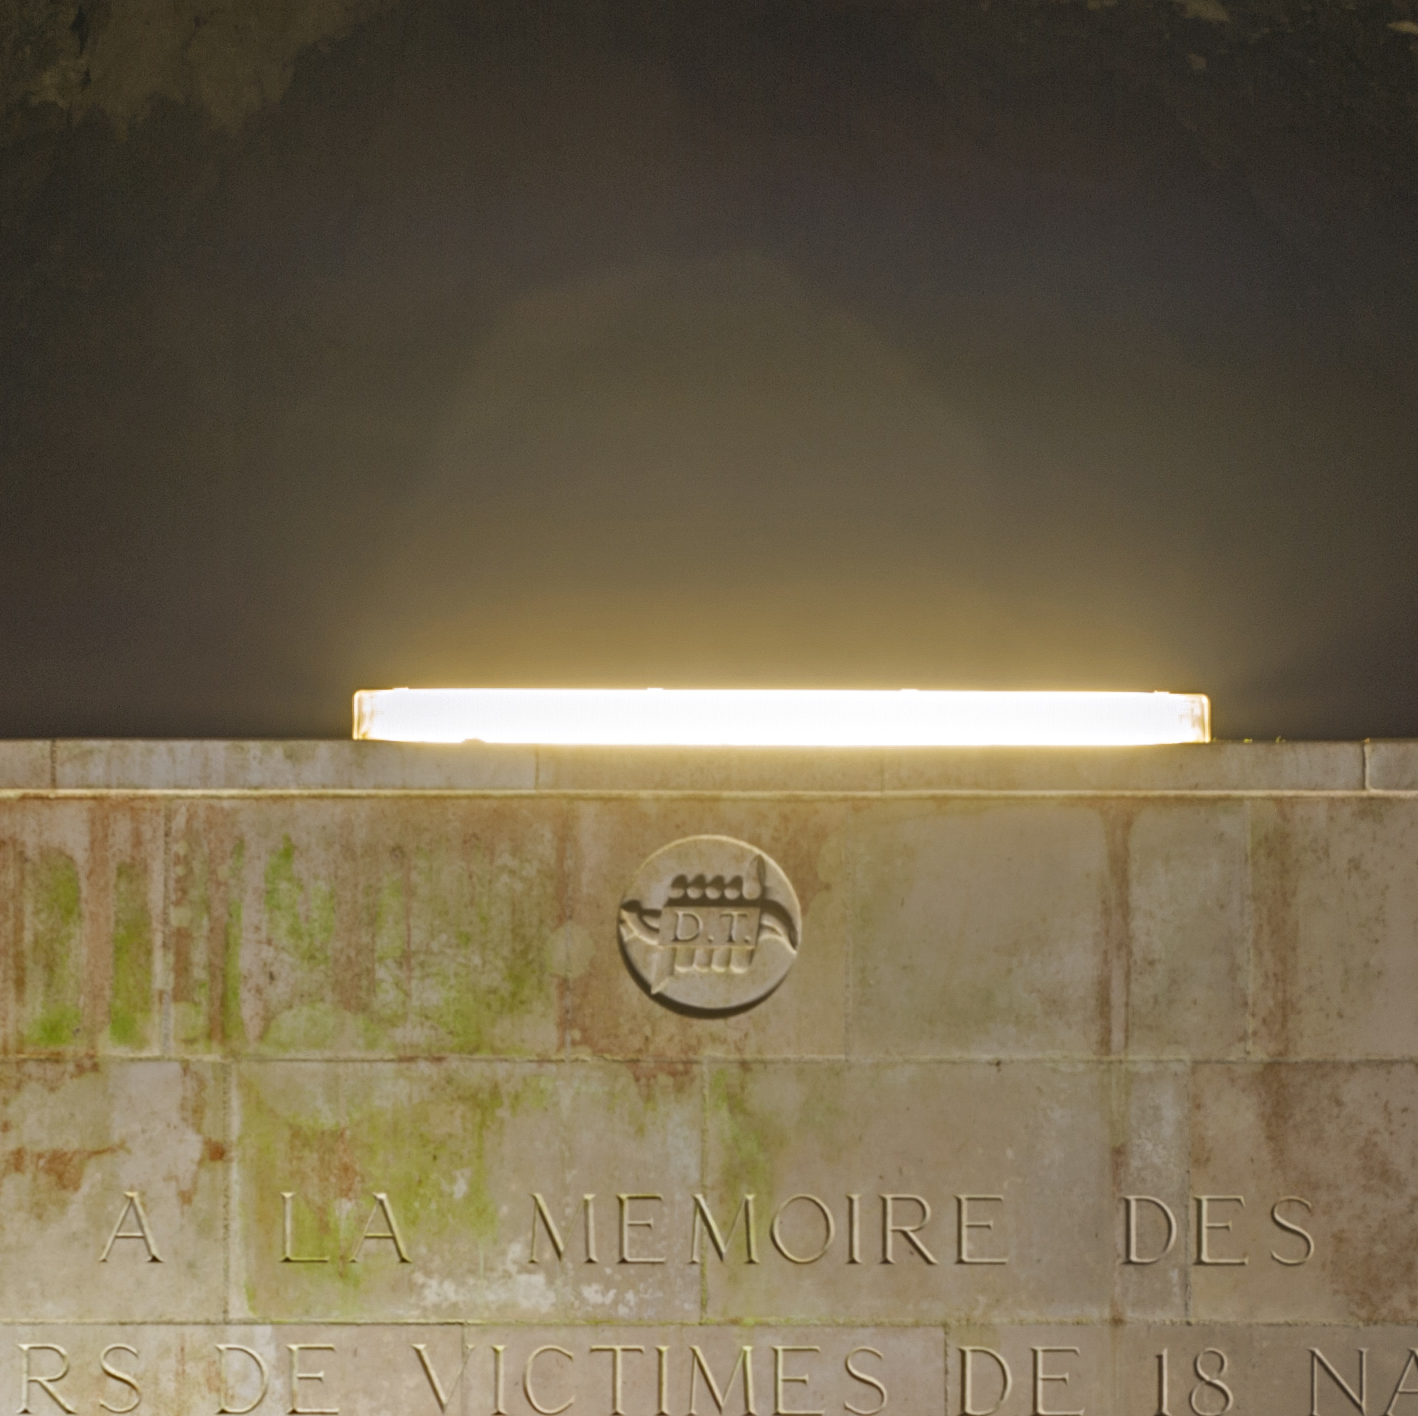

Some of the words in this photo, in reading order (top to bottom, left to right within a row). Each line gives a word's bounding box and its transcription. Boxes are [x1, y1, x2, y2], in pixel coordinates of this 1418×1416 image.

[98, 1191, 163, 1263] A
[279, 1191, 413, 1263] LA
[527, 1192, 1009, 1267] MEMOIRE
[1121, 1194, 1316, 1266] DES
[214, 1342, 341, 1416] DE
[411, 1343, 888, 1416] VICTIMES
